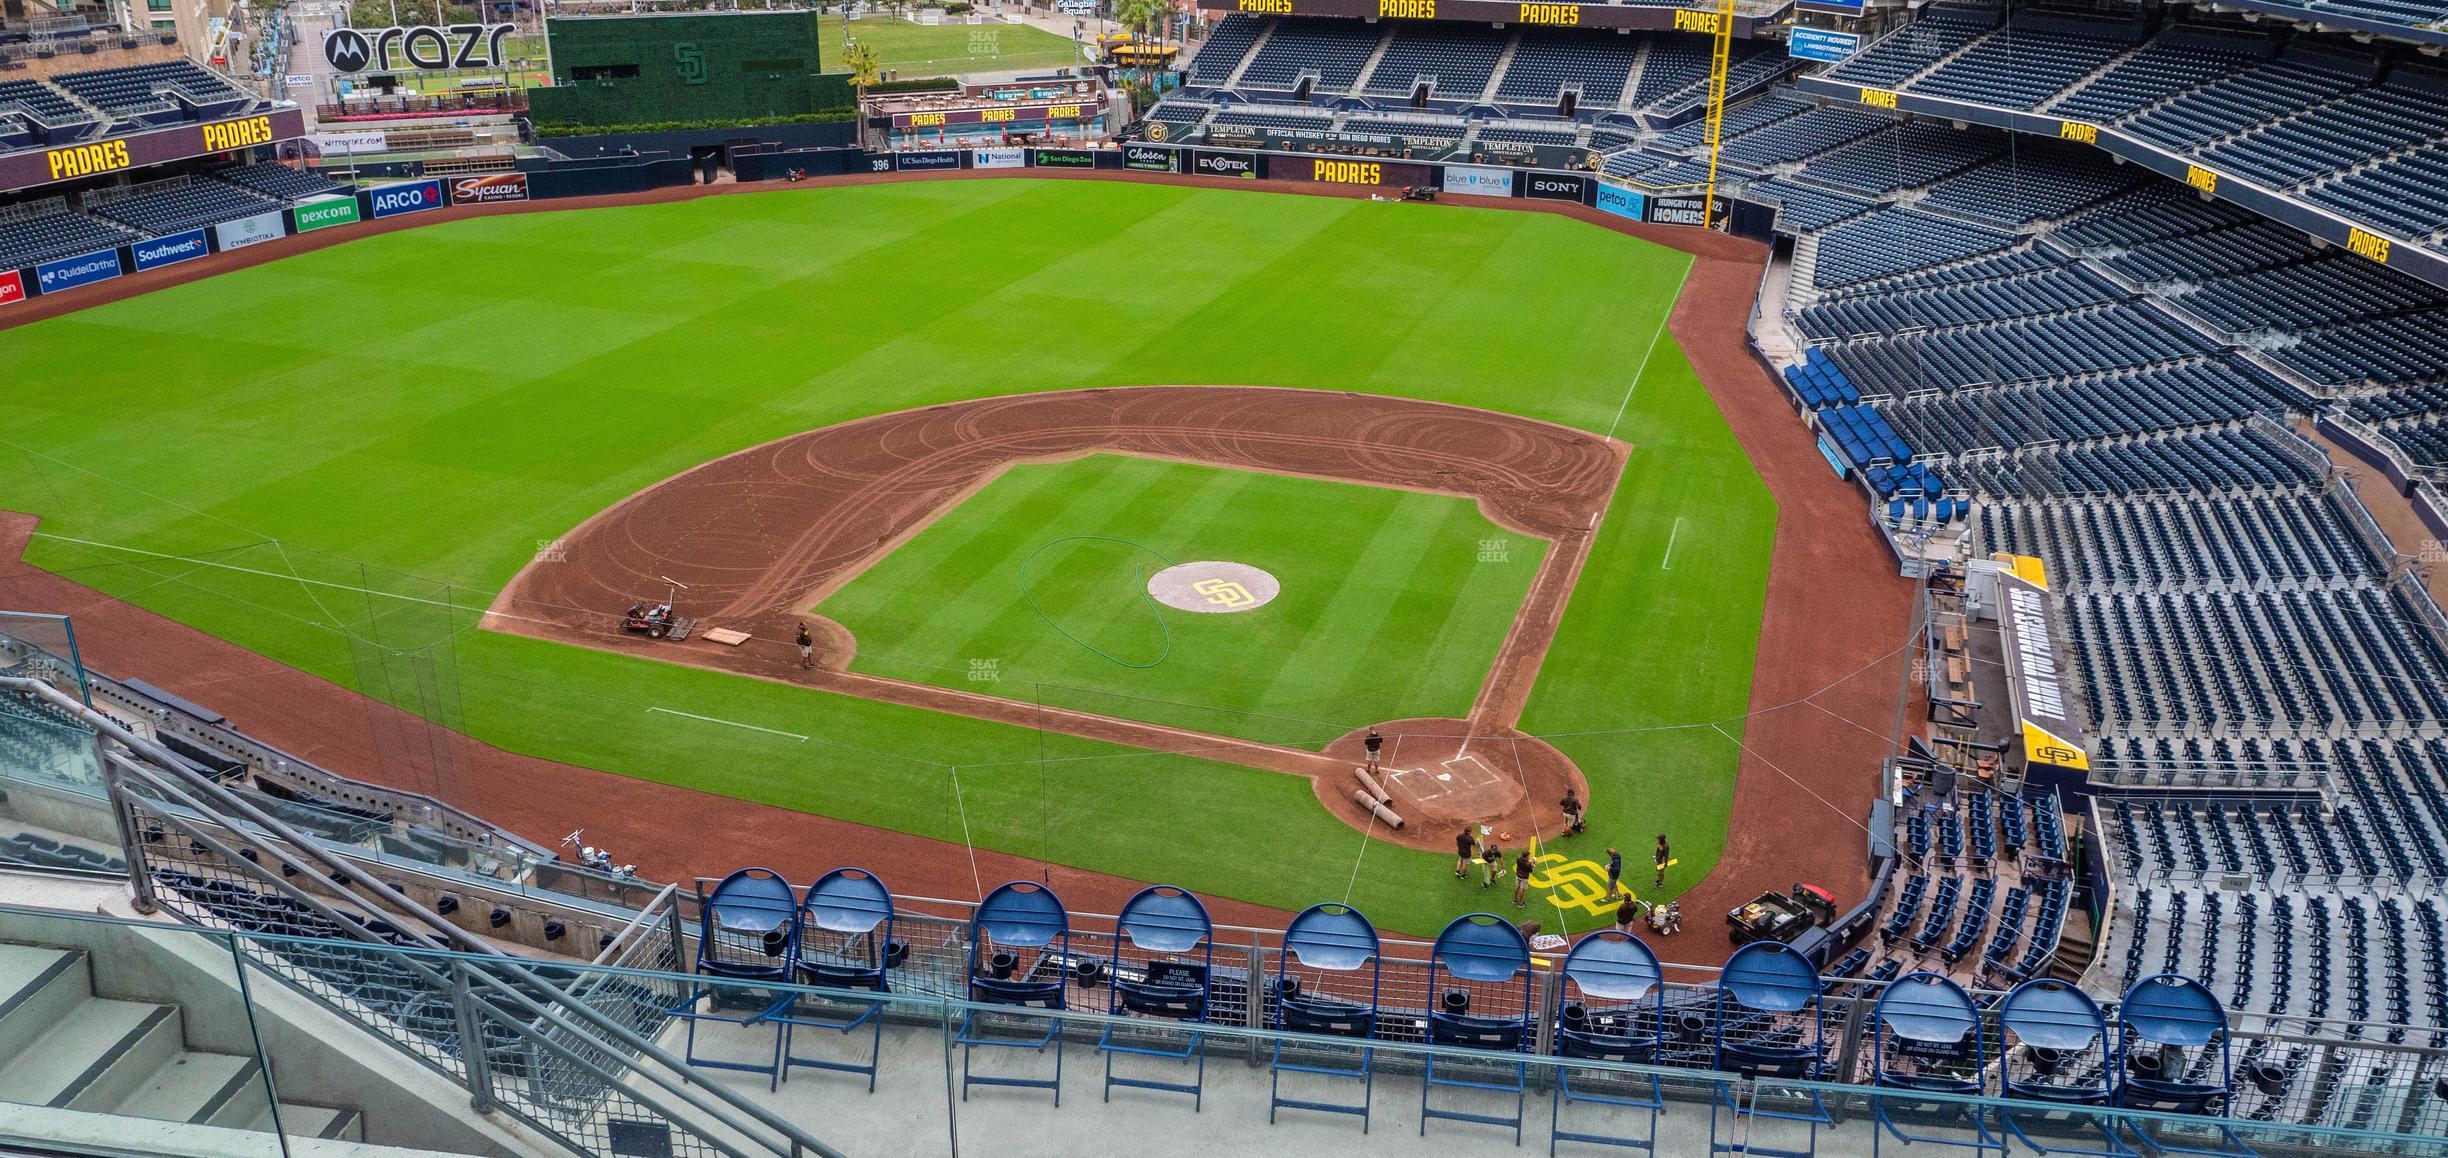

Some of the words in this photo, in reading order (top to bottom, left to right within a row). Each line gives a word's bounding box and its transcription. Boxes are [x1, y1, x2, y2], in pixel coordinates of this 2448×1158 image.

[1063, 7, 1092, 16] Square
[1239, 0, 1292, 12] PADRES
[1379, 0, 1436, 19] PADRES
[1519, 3, 1579, 26] PADRES
[1674, 9, 1718, 34] PADRES
[1794, 32, 1827, 42] ACCIDENT?
[376, 23, 516, 72] razr
[1861, 88, 1897, 109] PADRES
[911, 113, 946, 126] PADRES
[981, 109, 1015, 122] PADRES
[1048, 105, 1081, 118] PADRES
[203, 116, 272, 151] PADRES
[1208, 125, 1255, 136] TEMPLETON
[1266, 129, 1295, 138] OFFICIAL
[1295, 131, 1324, 140] WHISKEY
[1351, 134, 1368, 142] DIEGO
[1369, 135, 1391, 144] PADRES
[2060, 121, 2098, 145] PADRES
[1402, 137, 1452, 149] TEMPLETON
[1482, 142, 1534, 153] TEMPLETON
[47, 139, 130, 179] PADRES
[1128, 147, 1167, 160] Chosen
[872, 159, 889, 171] 396
[1200, 157, 1249, 171] EVOTEK
[1313, 159, 1381, 185] PADRES
[1446, 173, 1468, 183] blue
[1479, 175, 1500, 186] blue
[1534, 180, 1580, 193] SONY
[2186, 164, 2217, 193] PADRES
[455, 178, 520, 202] Sycuan
[375, 189, 423, 212] ARCO
[1599, 191, 1627, 207] petco
[1657, 198, 1688, 208] HUNGRY
[1688, 200, 1703, 209] FOR
[1653, 207, 1706, 225] HOMERS
[230, 232, 275, 248] CYMBIOTIKA
[2346, 226, 2390, 264] PADRES
[138, 240, 195, 263] Southwest
[58, 258, 116, 281] QuidelOrtho
[0, 283, 17, 297] on
[2008, 587, 2044, 616] FANS
[2012, 612, 2053, 657] PADRES
[2020, 652, 2057, 681] YOU
[2024, 675, 2066, 721] THANK
